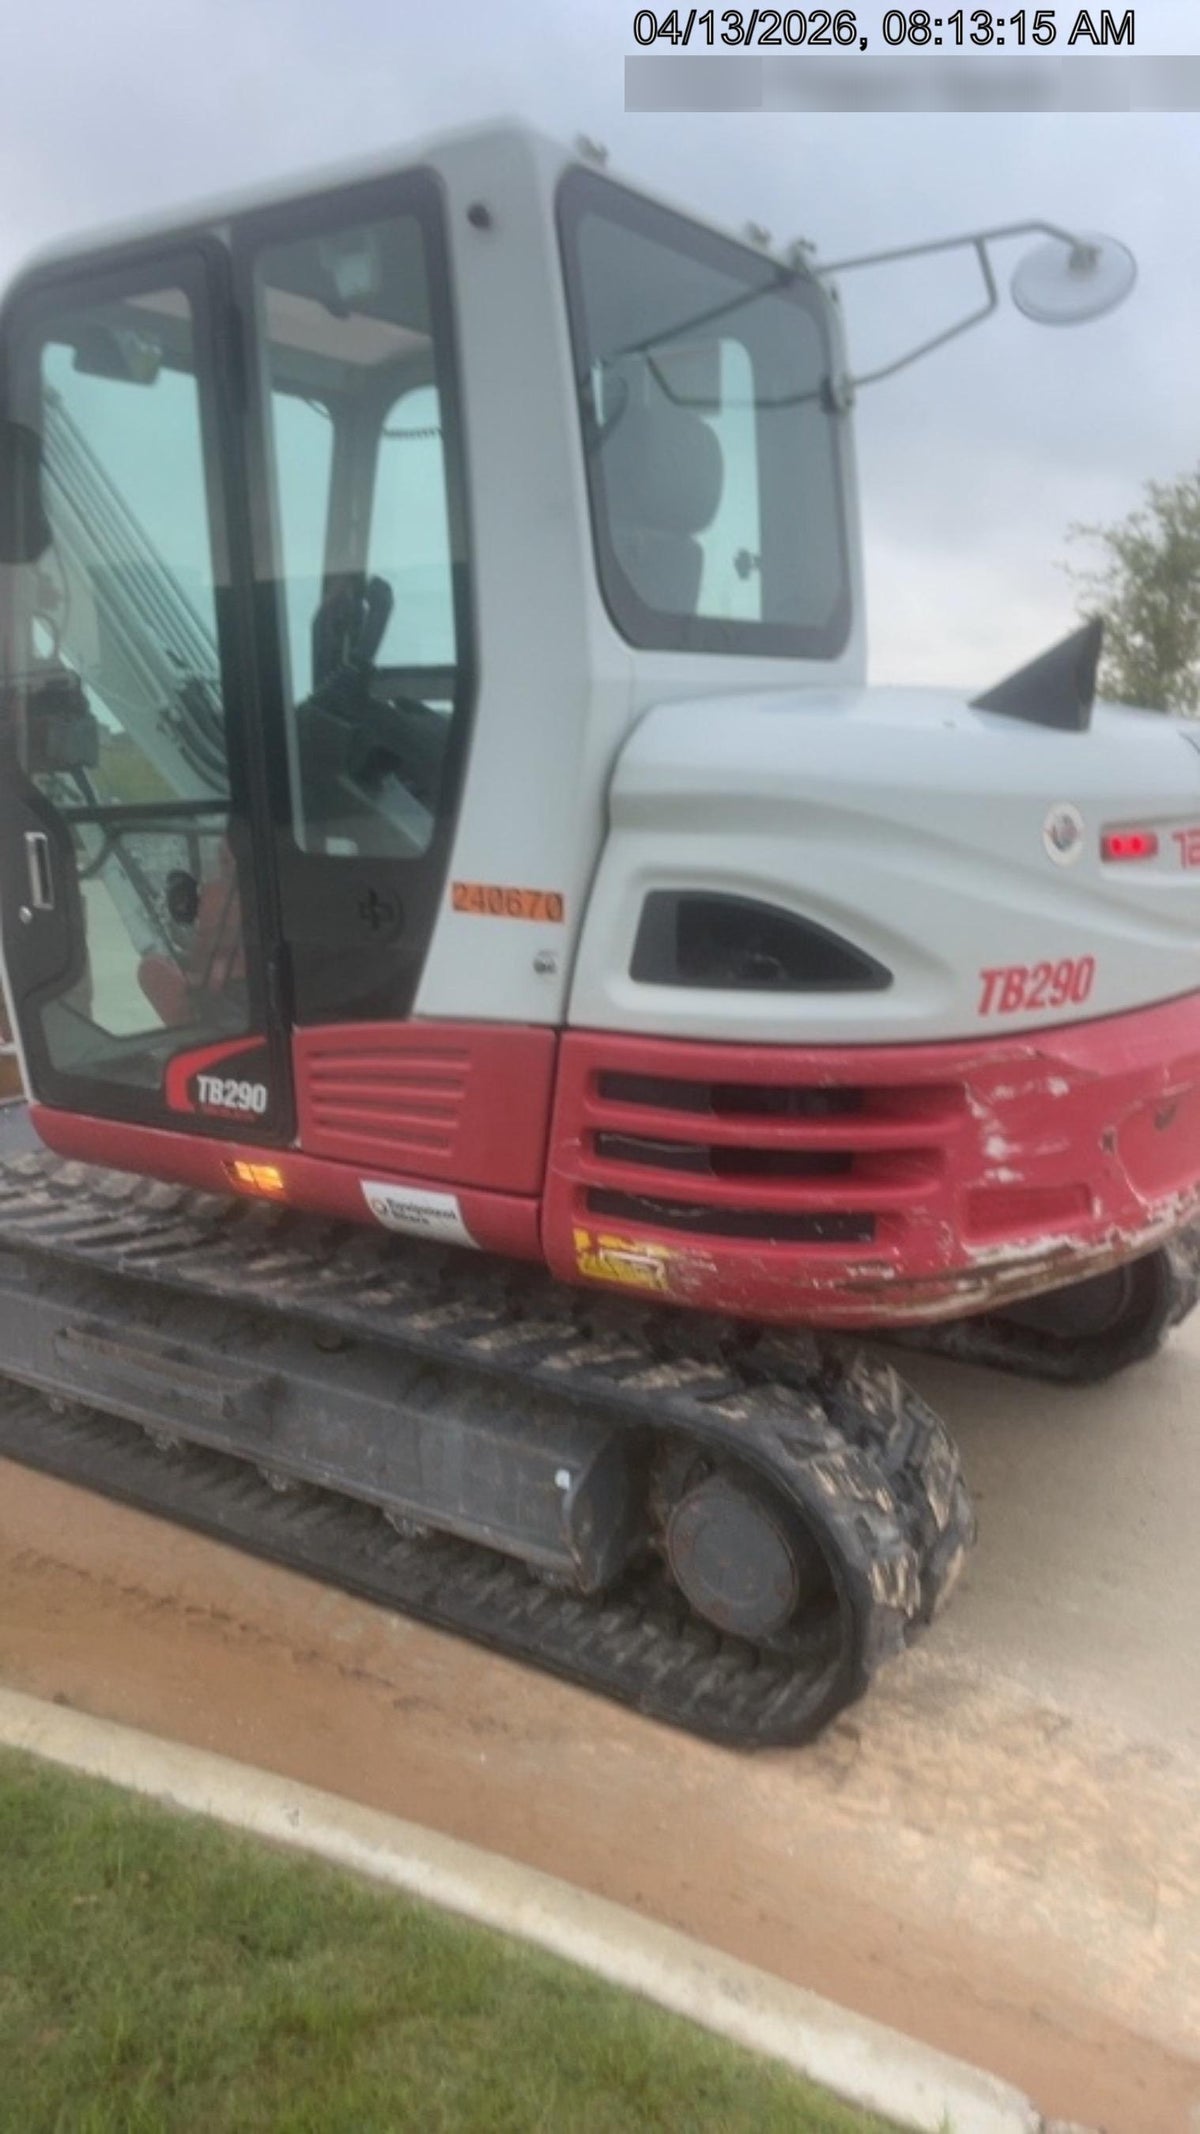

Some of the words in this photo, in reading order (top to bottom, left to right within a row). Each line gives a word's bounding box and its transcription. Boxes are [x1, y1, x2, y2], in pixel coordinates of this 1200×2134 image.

[452, 882, 563, 922] 240670
[978, 955, 1095, 1016] TB290
[196, 1073, 268, 1114] TB290
